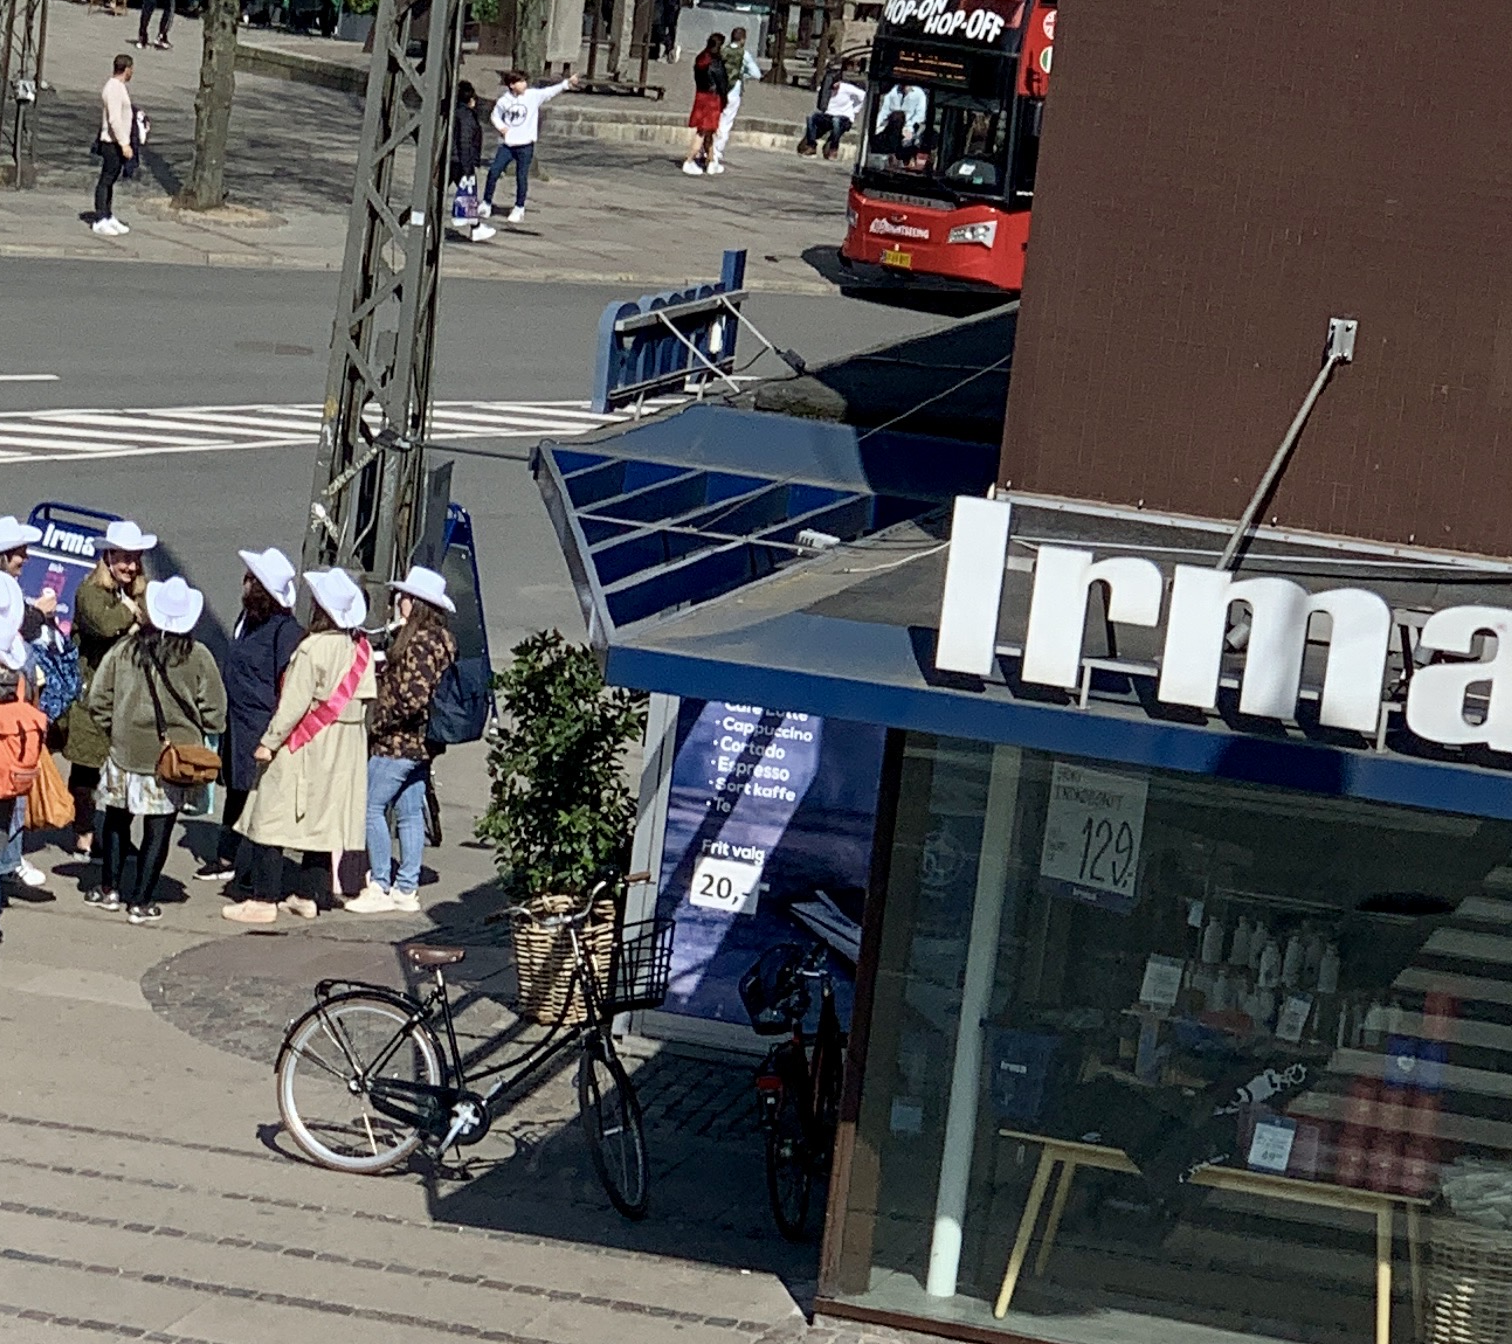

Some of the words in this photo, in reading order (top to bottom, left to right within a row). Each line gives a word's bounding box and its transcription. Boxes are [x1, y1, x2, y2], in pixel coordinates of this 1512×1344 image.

[923, 9, 1005, 43] HOP-OFF
[42, 523, 96, 557] Irma
[935, 495, 1512, 753] Irma
[722, 716, 813, 743] Cappuccino
[720, 736, 786, 760] Cortado
[717, 756, 790, 781] Espresso
[715, 777, 752, 795] Sort
[753, 782, 796, 802] kaffe
[715, 797, 731, 813] Te
[702, 839, 729, 857] Frit
[732, 843, 766, 865] valg
